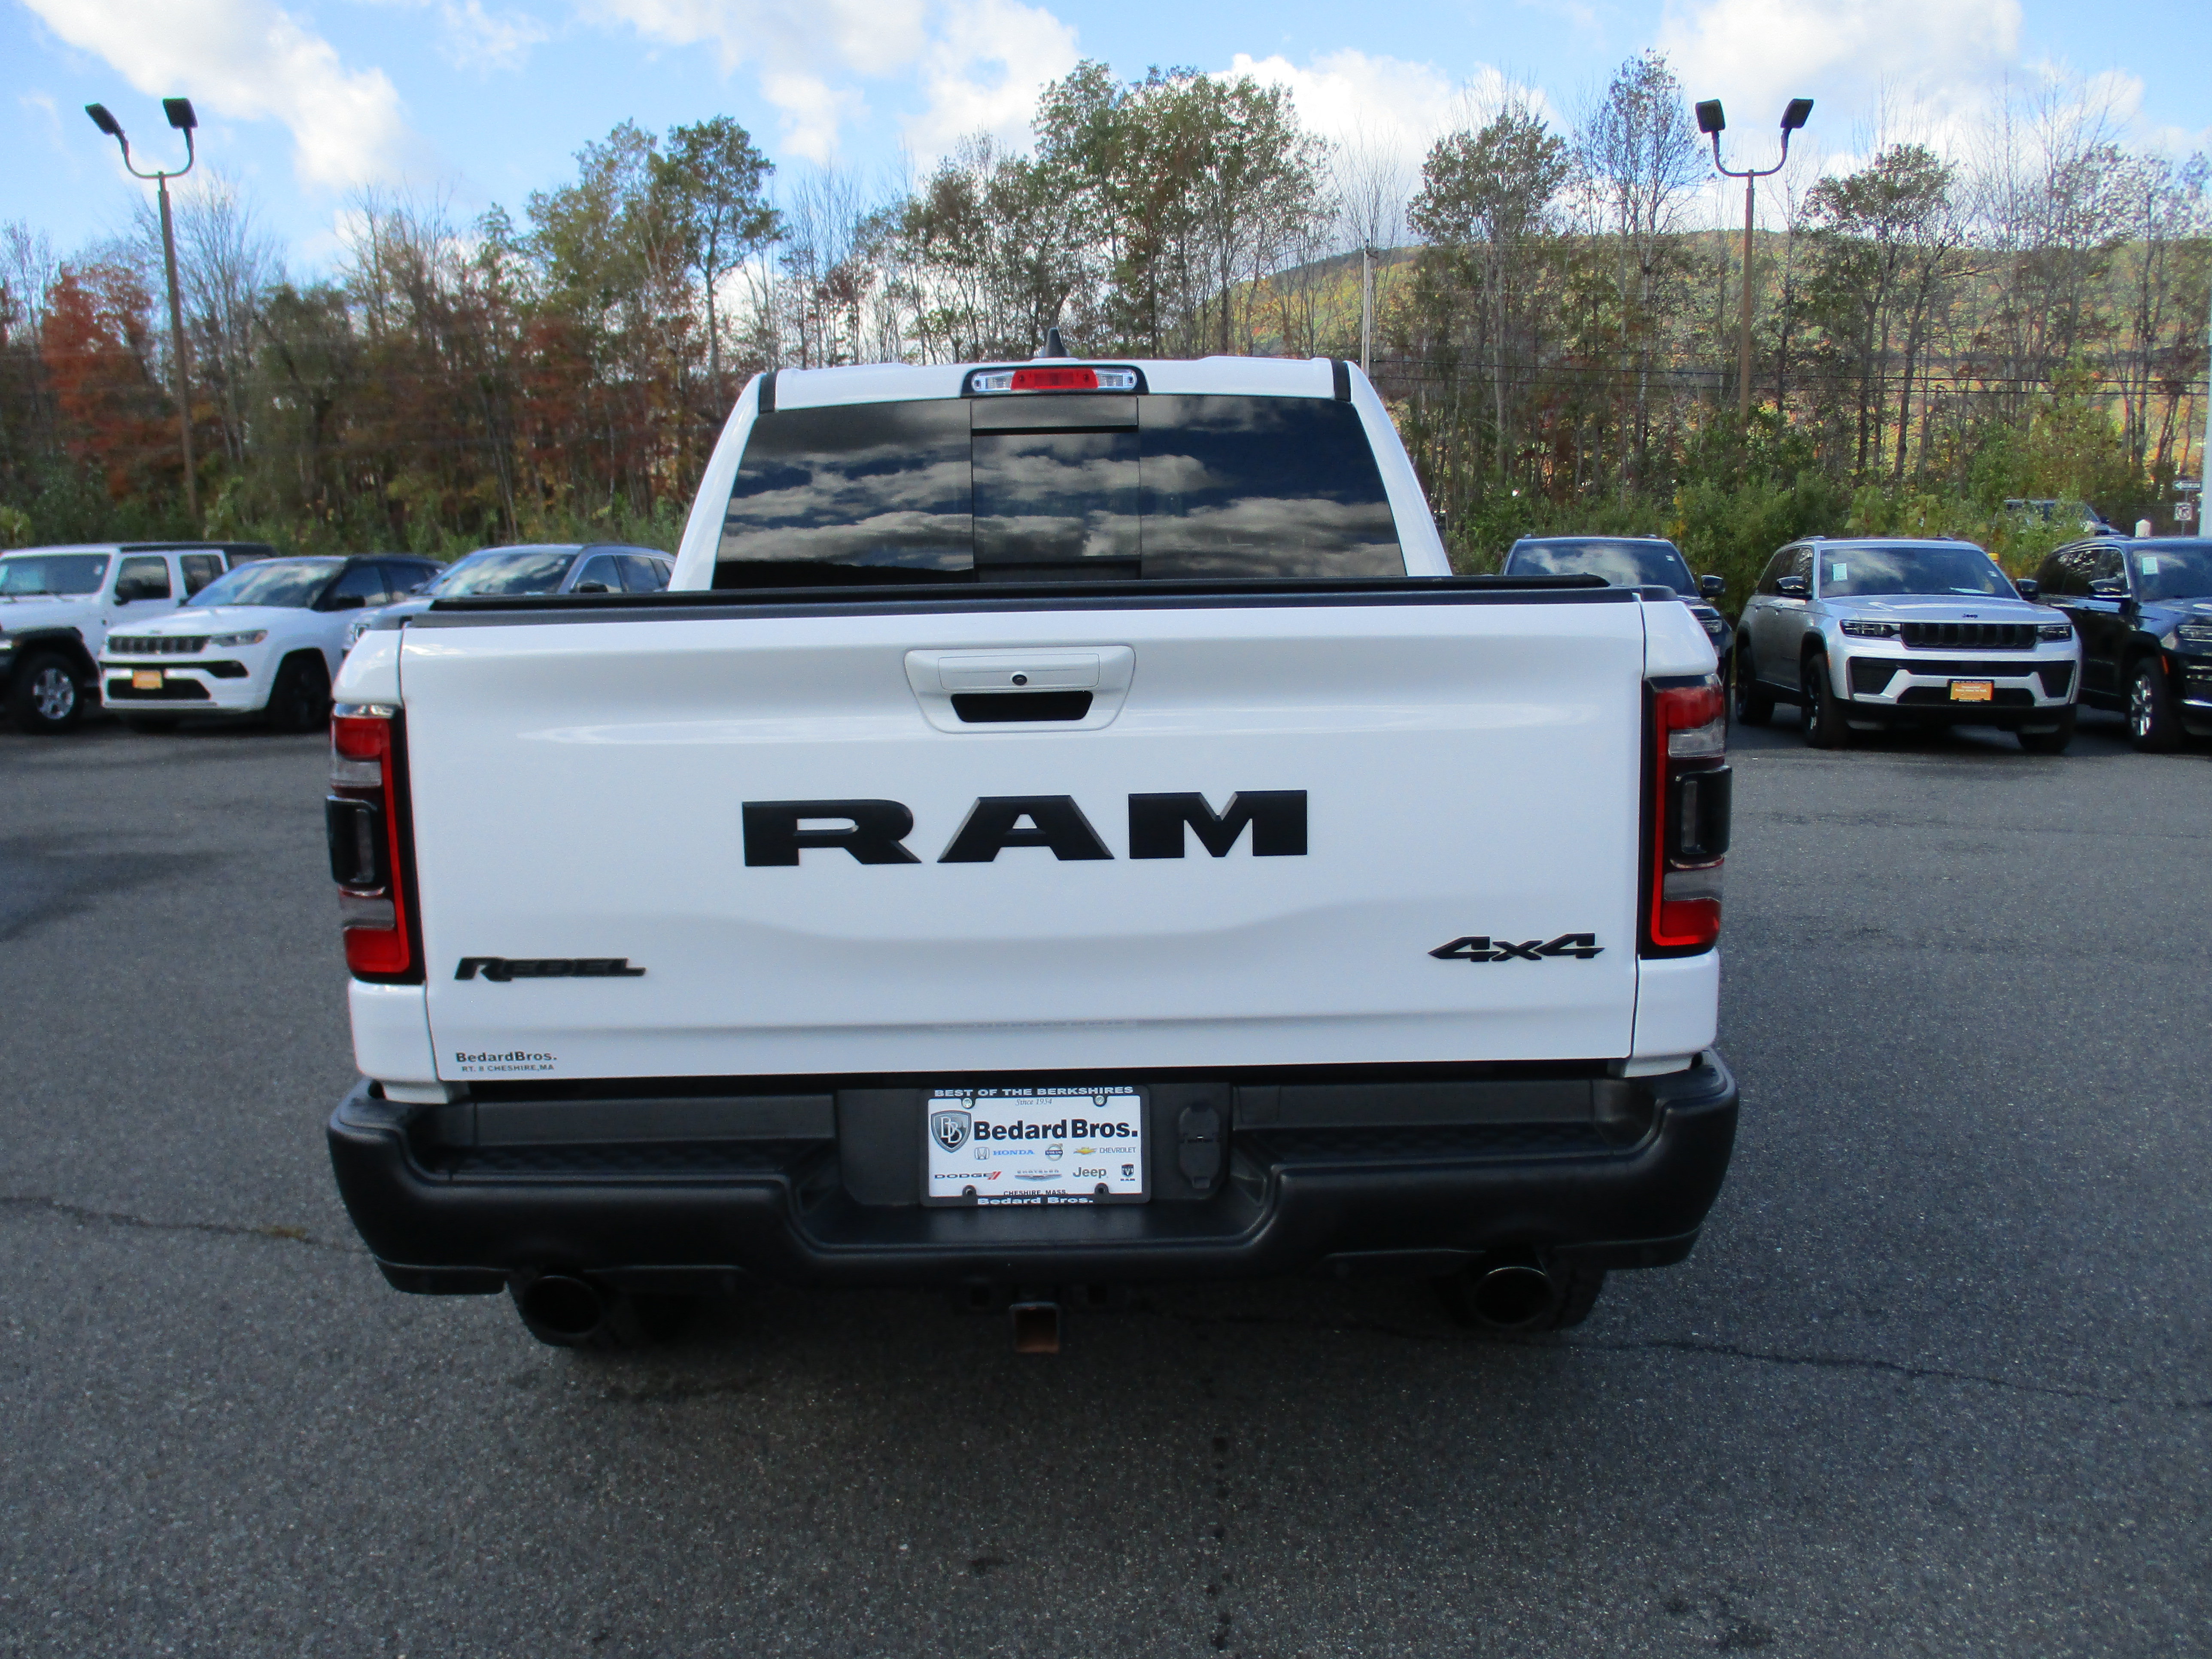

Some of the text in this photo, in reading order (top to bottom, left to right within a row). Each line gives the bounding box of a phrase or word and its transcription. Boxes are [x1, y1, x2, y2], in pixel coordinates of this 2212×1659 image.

[742, 789, 1307, 867] RAM
[1428, 933, 1605, 962] 4x4
[1037, 1086, 1133, 1095] BERKSHIRES
[974, 1118, 1138, 1140] Bedard Bros.
[1073, 1166, 1107, 1179] Jeep
[978, 1197, 1041, 1205] Bedard
